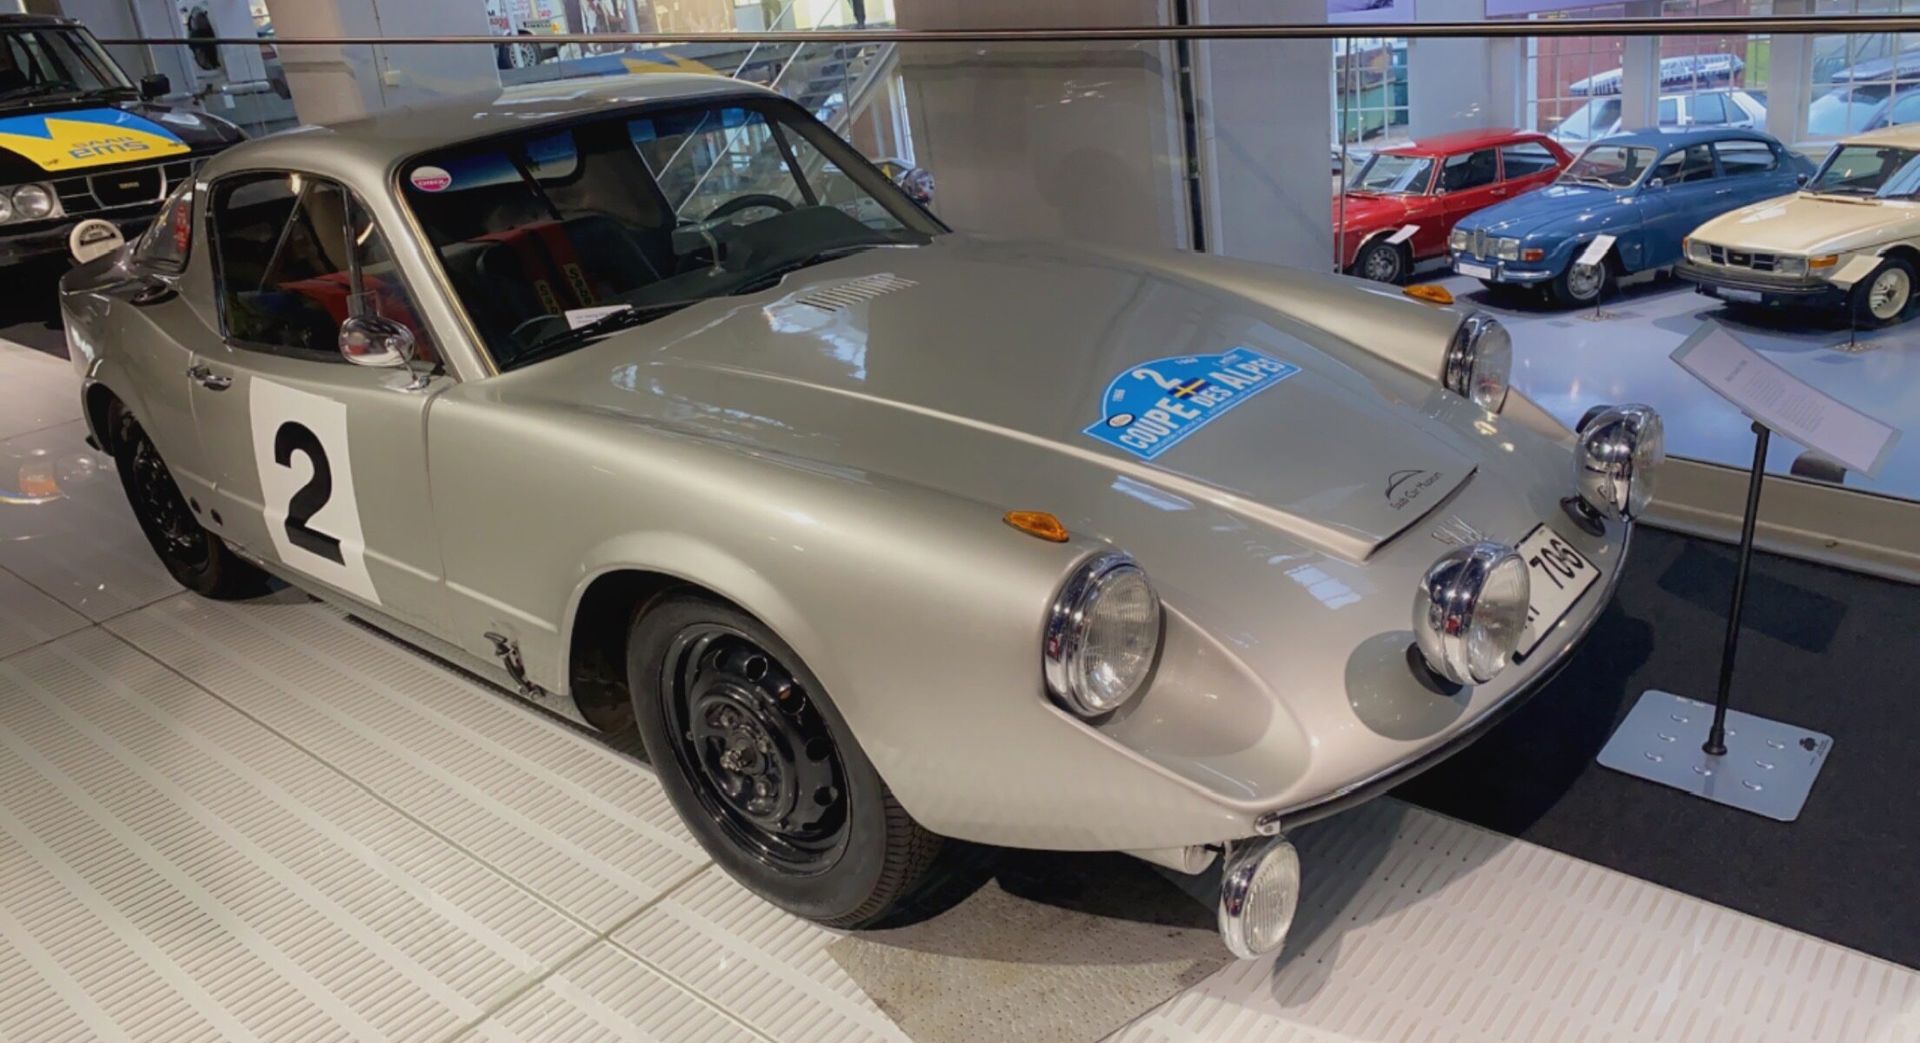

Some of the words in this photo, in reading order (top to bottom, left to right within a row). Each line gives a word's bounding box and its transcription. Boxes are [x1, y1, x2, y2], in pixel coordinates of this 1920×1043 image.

[68, 142, 150, 159] ems
[1131, 367, 1183, 390] 2
[1208, 357, 1286, 390] ALPES
[1192, 385, 1233, 408] DES
[1119, 397, 1202, 450] COUPE
[273, 420, 347, 568] 2
[1529, 538, 1584, 590] 706
